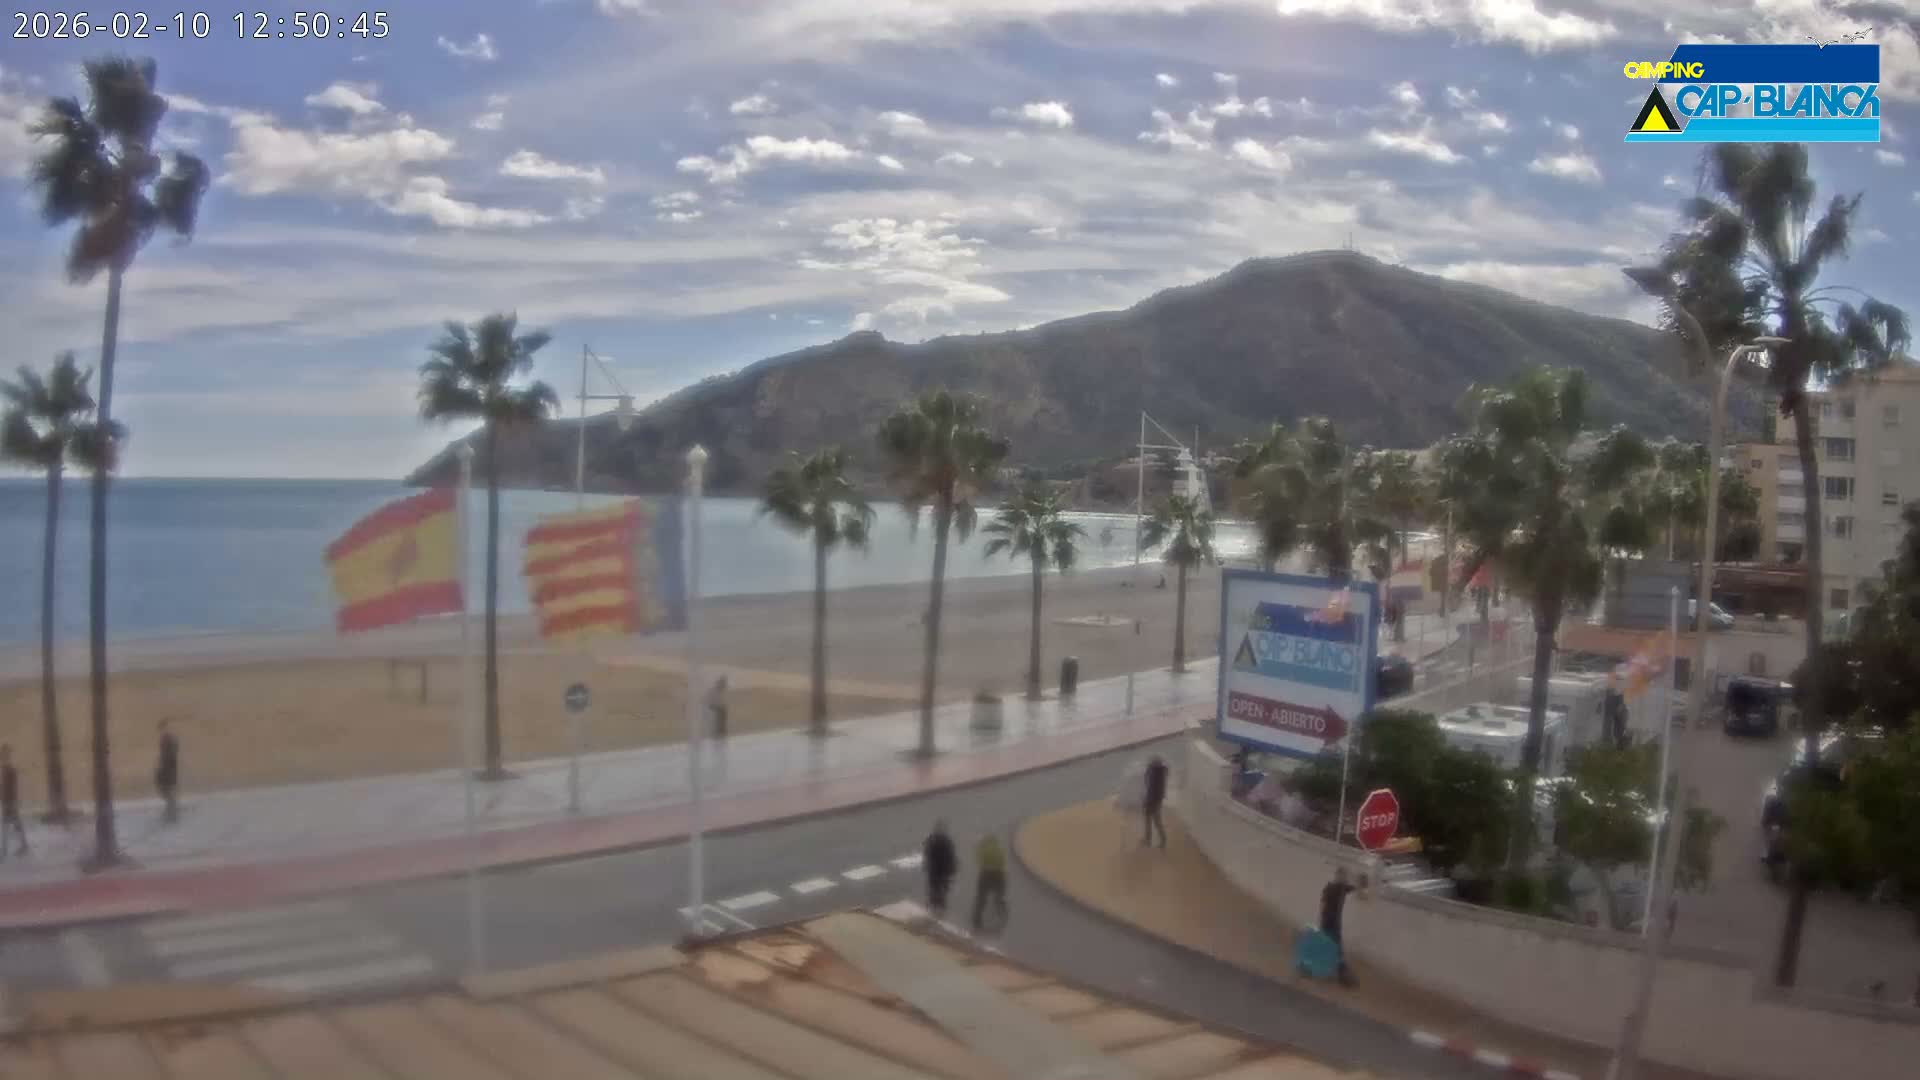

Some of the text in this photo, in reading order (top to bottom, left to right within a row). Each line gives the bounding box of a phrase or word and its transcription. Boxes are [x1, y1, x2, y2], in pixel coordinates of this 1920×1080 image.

[1231, 698, 1264, 718] OPEN
[1271, 706, 1326, 733] ABIERTO
[1361, 812, 1395, 831] STOP
